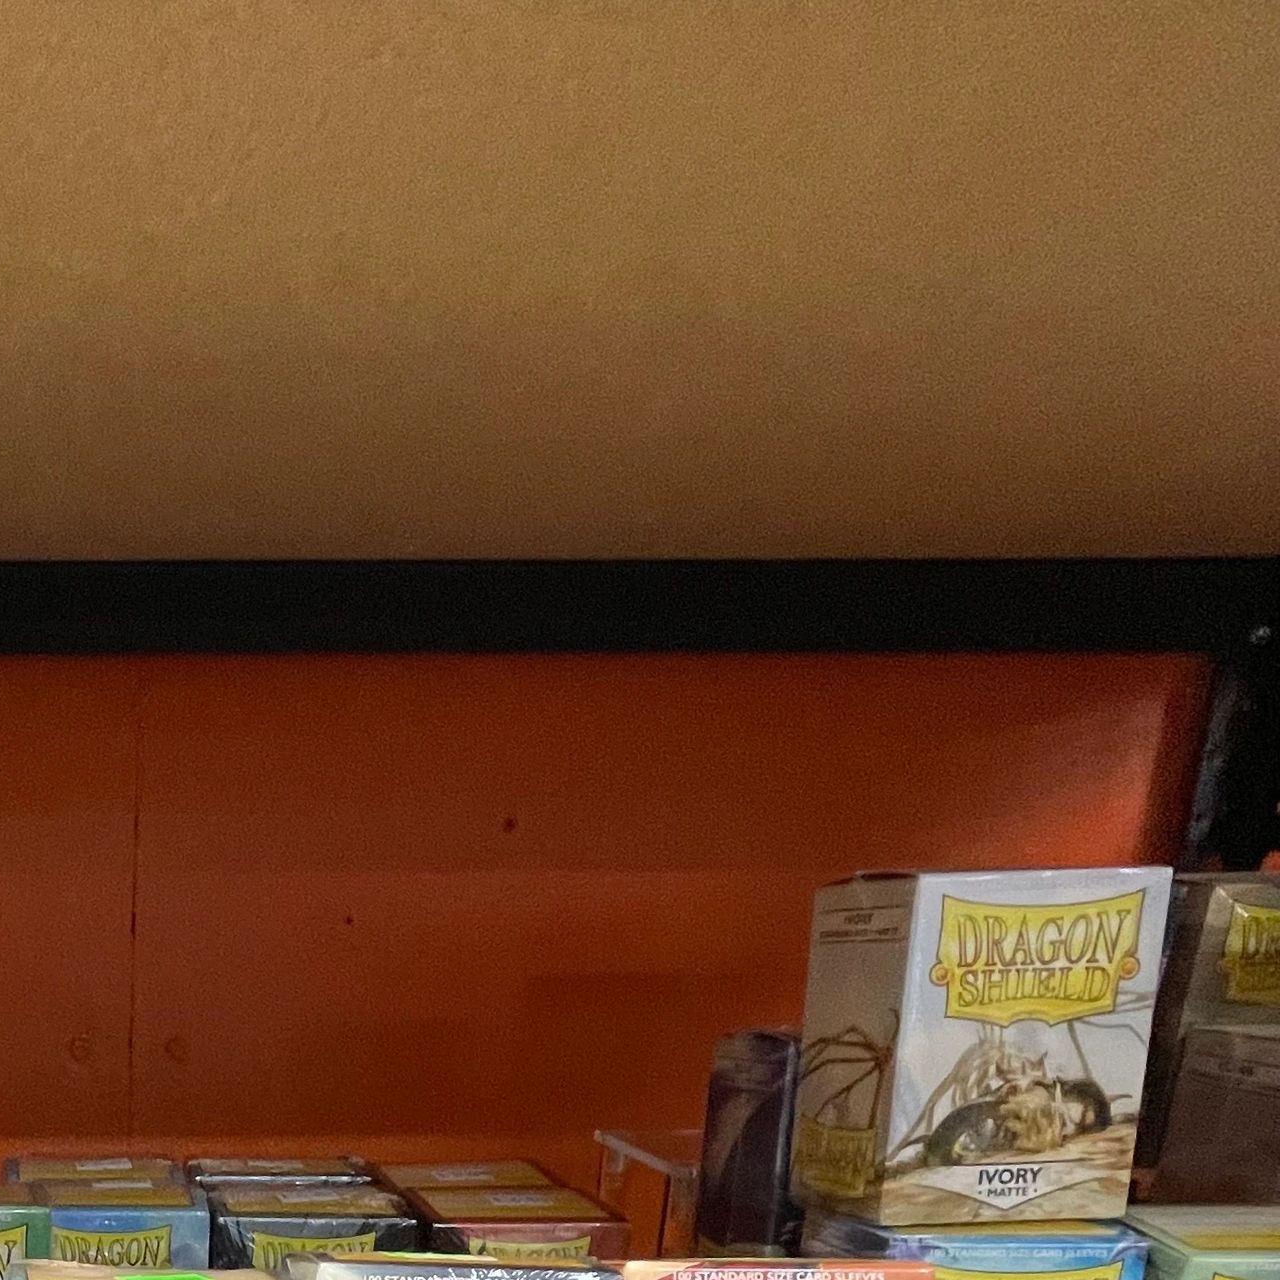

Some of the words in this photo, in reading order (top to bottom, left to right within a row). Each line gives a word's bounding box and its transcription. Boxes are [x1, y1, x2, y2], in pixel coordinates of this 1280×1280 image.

[956, 908, 1132, 968] DRAGON
[957, 965, 1112, 1007] SHIELD
[978, 1166, 1043, 1187] IVORY
[986, 1186, 1029, 1198] MATTE
[60, 1235, 164, 1267] DRAGON
